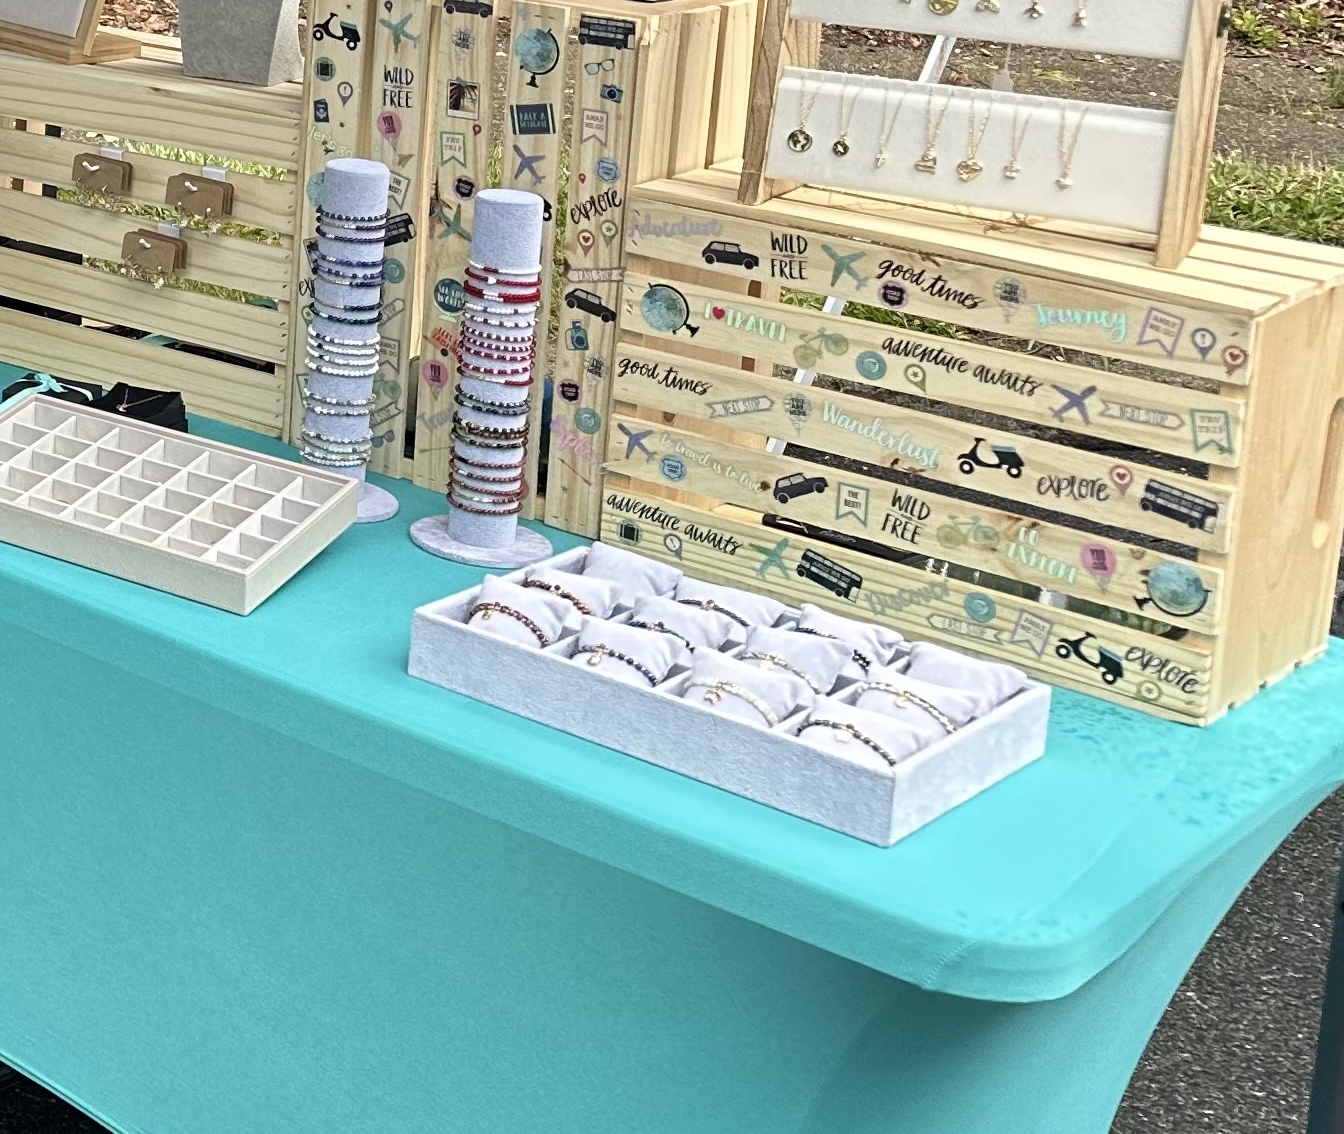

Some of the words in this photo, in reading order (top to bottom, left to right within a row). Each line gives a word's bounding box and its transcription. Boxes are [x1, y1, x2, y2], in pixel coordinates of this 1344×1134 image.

[383, 64, 414, 86] WILD
[382, 89, 414, 109] FREE
[570, 188, 623, 225] explore
[770, 230, 808, 255] WILD
[771, 258, 808, 280] FREE
[875, 259, 926, 286] good
[921, 274, 987, 310] times
[1030, 303, 1128, 344] Journey
[617, 357, 659, 380] good
[657, 367, 713, 396] times
[882, 337, 969, 374] adventure
[973, 364, 1044, 397] awaits
[822, 400, 941, 469] Wanderlust
[675, 442, 712, 466] travel
[713, 462, 723, 473] is
[740, 472, 763, 494] live
[891, 488, 932, 521] WILD
[1037, 475, 1110, 501] explore
[607, 494, 681, 530] adventure
[684, 523, 743, 556] awaits
[881, 513, 923, 546] FREE
[1125, 646, 1200, 695] explore
